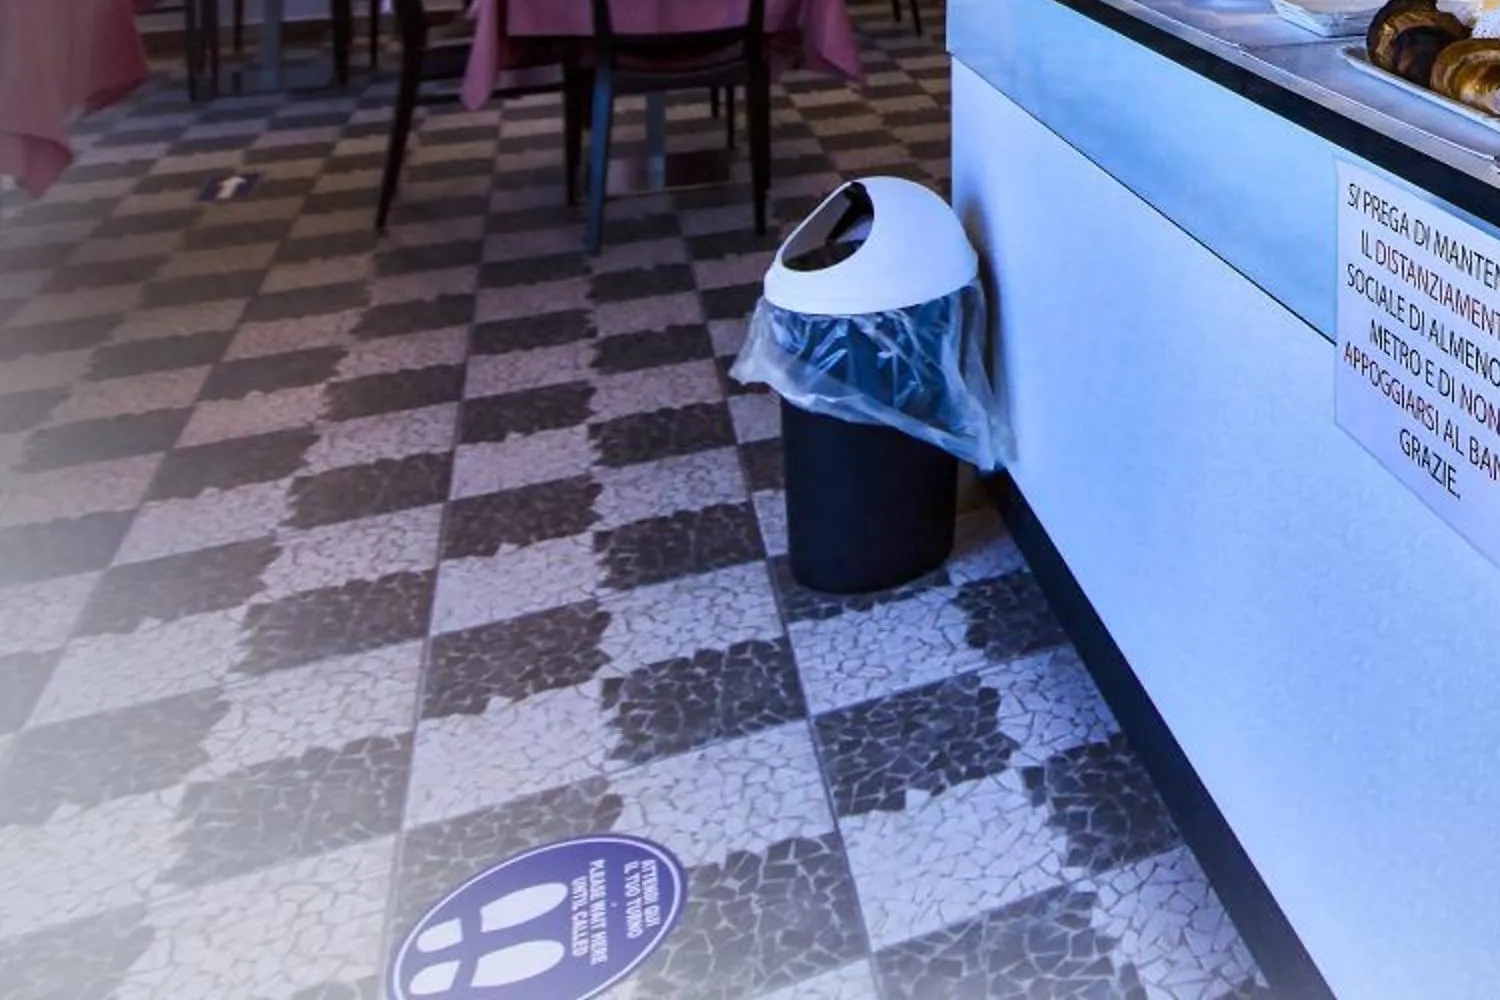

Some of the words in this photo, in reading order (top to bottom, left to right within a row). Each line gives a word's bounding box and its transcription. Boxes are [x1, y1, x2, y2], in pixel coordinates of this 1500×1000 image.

[1347, 182, 1361, 211] SI
[1363, 191, 1410, 240] PREGA
[1413, 218, 1431, 251] DI
[1361, 229, 1372, 260] IL
[1347, 263, 1405, 324] SOCIALE
[1409, 303, 1425, 337] DI
[1343, 341, 1439, 437] APPOGGIARSI
[1443, 417, 1464, 457] AL
[1370, 318, 1421, 377] METRO
[1425, 358, 1435, 389] E
[1438, 366, 1455, 404] DI
[1460, 383, 1500, 437] NON
[1399, 427, 1461, 500] GRAZIE.
[571, 875, 588, 911] UNTIL
[589, 858, 606, 902] PLEASE
[624, 873, 641, 898] TUO
[571, 911, 589, 957] CALLED
[590, 900, 607, 930] WAIT
[625, 897, 644, 939] TURNO
[591, 930, 608, 966] HERE
